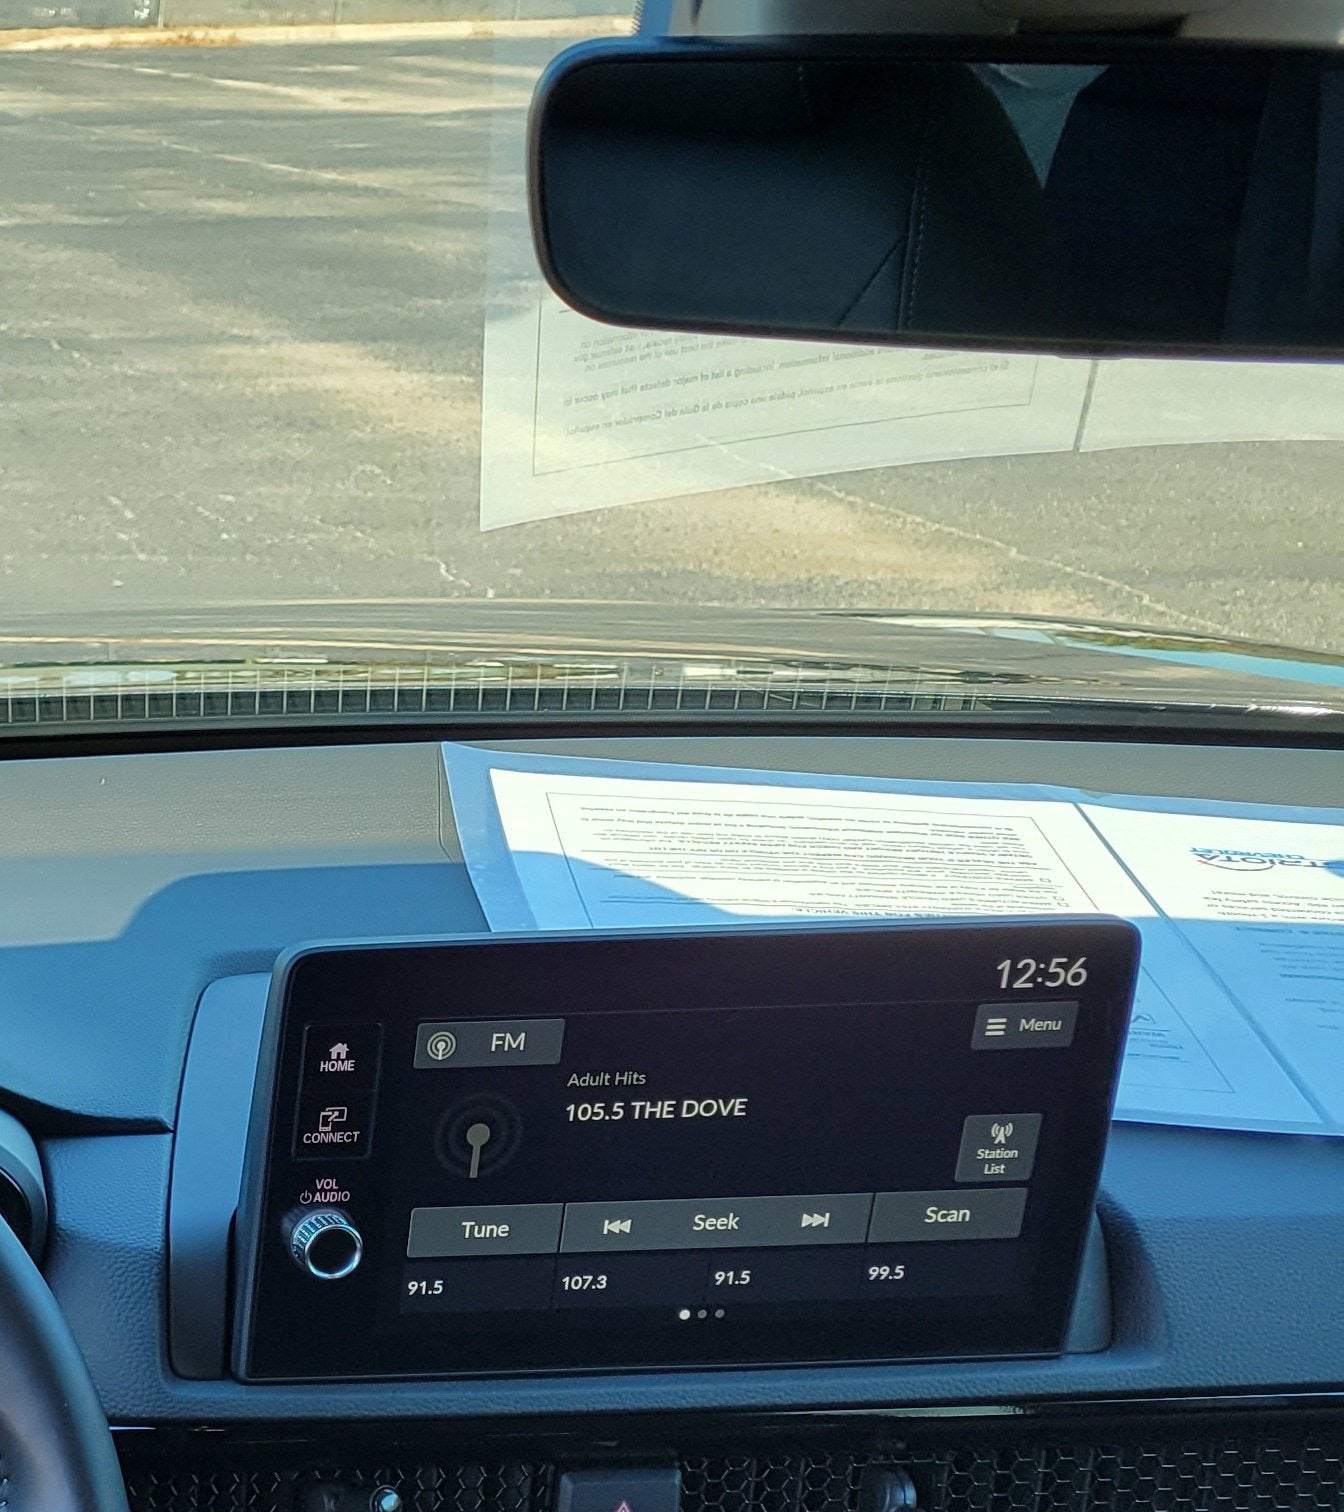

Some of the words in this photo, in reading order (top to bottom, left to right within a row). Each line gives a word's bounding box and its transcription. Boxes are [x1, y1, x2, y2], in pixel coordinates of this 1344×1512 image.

[994, 956, 1089, 991] 12:56
[1019, 1015, 1063, 1034] Menu
[490, 1031, 526, 1053] FM
[319, 1060, 356, 1073] HOME
[567, 1069, 608, 1088] Adult
[615, 1069, 647, 1087] Hits
[564, 1101, 626, 1122] 105.5
[630, 1099, 676, 1121] THE
[681, 1097, 748, 1119] DOVE
[302, 1131, 361, 1144] CONNECT
[976, 1147, 1019, 1161] Station
[983, 1162, 1007, 1176] List
[315, 1179, 340, 1190] VOL
[313, 1191, 351, 1203] AUDIO
[460, 1220, 511, 1241] Tune
[692, 1211, 740, 1232] Seek
[923, 1205, 972, 1225] Scan
[406, 1278, 445, 1297] 91.5
[560, 1273, 609, 1293] 107.3
[713, 1269, 752, 1288] 91.5
[867, 1264, 906, 1283] 99.5
